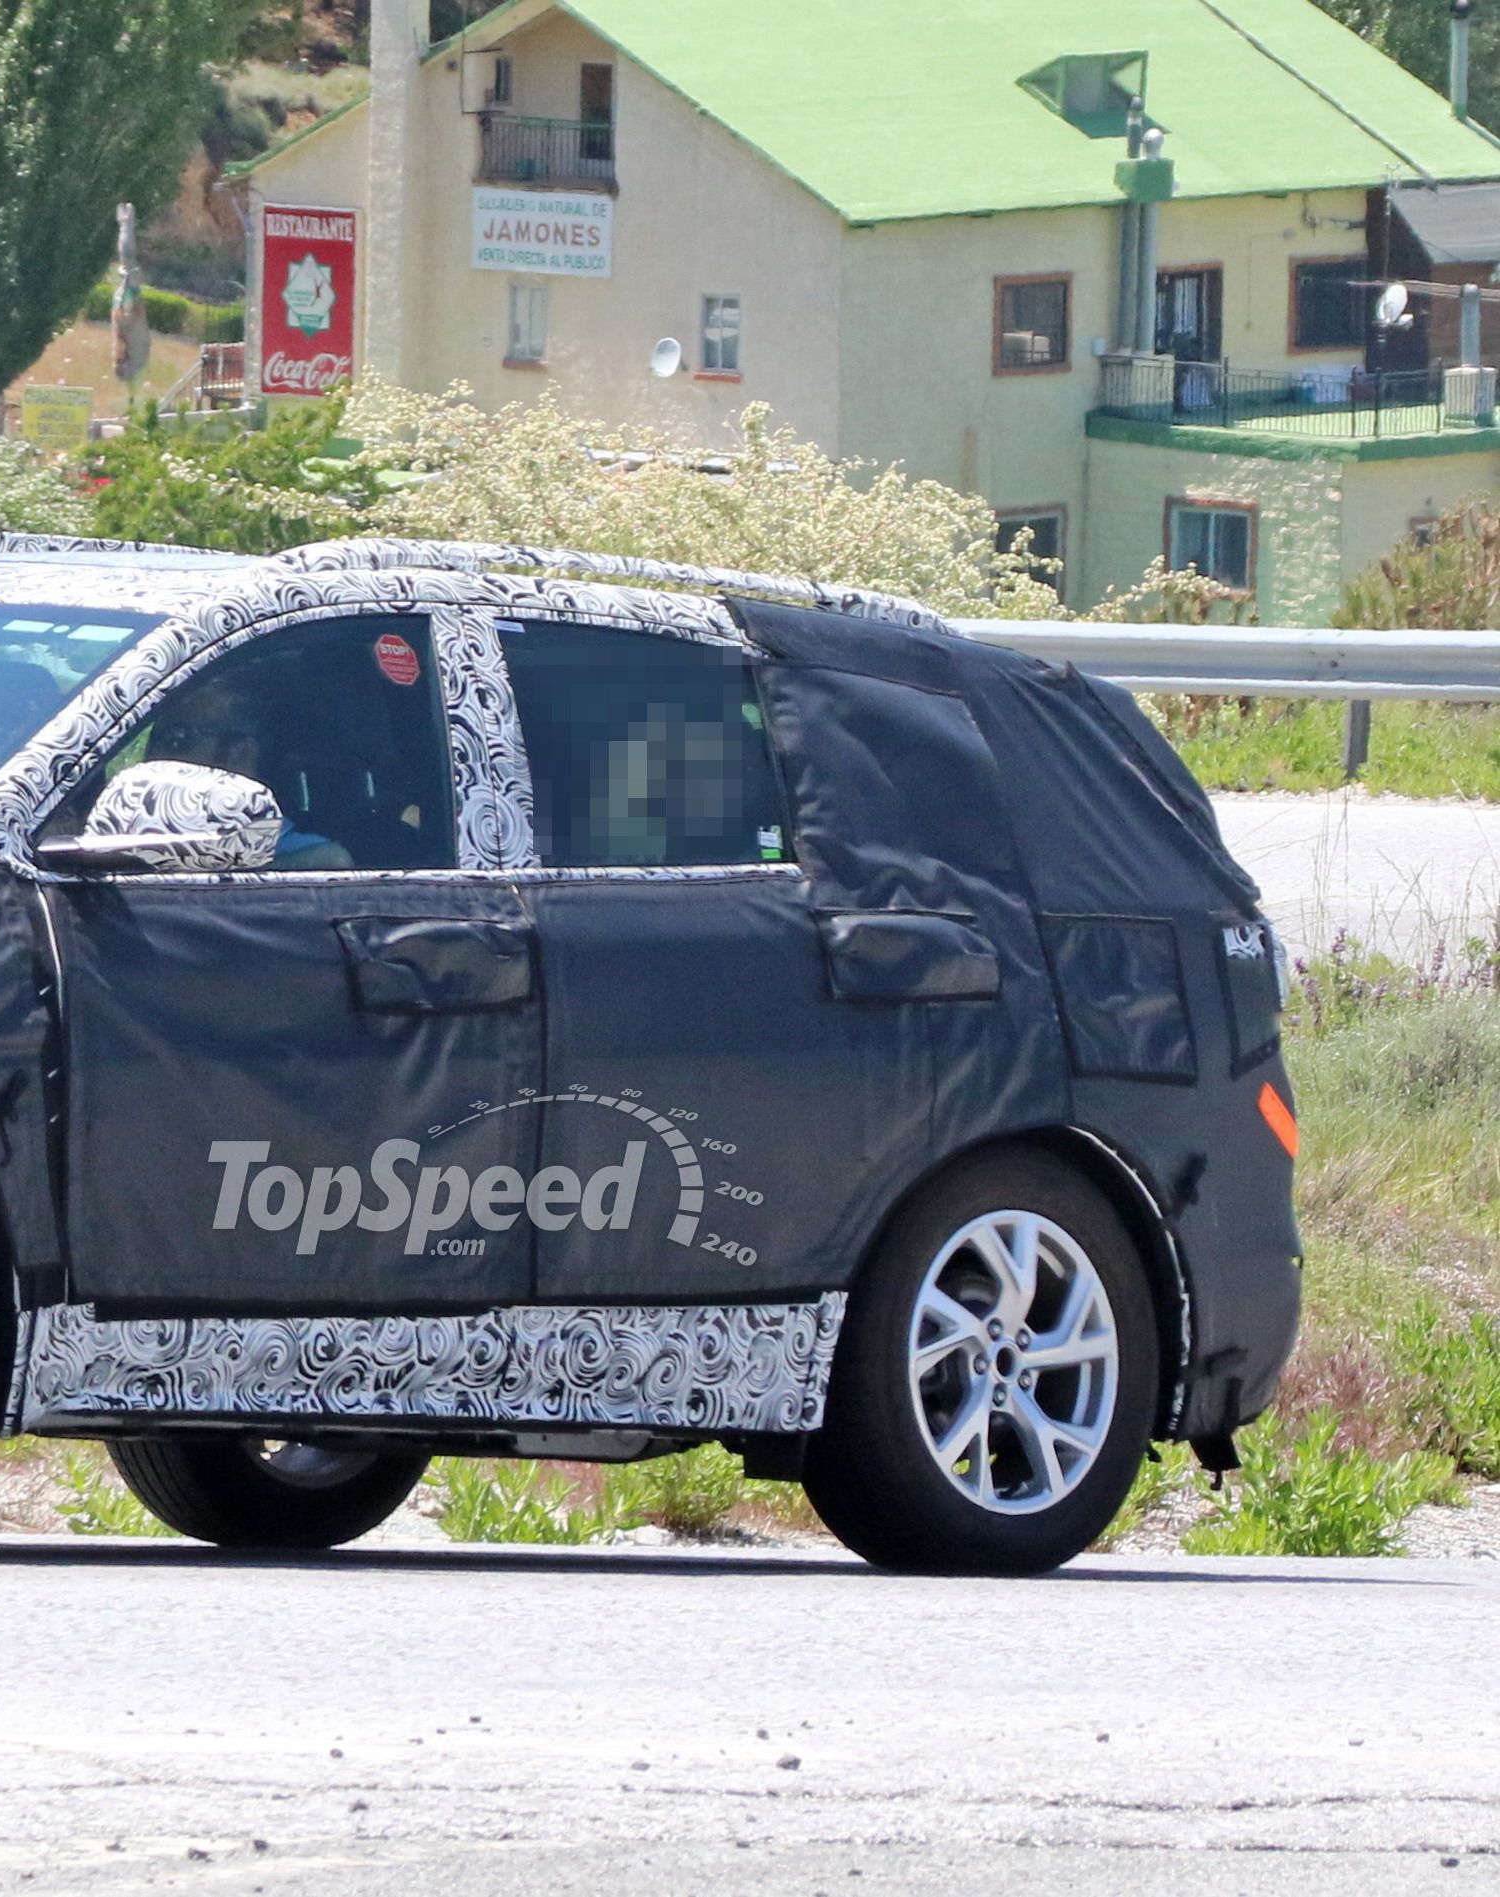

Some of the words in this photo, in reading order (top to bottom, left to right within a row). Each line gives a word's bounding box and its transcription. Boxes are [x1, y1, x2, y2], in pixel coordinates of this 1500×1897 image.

[538, 201, 589, 217] NATURAL
[592, 203, 608, 218] DE
[266, 213, 353, 242] RESTAURANTE
[483, 218, 601, 247] JAMONES
[477, 247, 505, 262] VENTA
[507, 250, 547, 265] DIRECTA
[549, 254, 561, 268] AL
